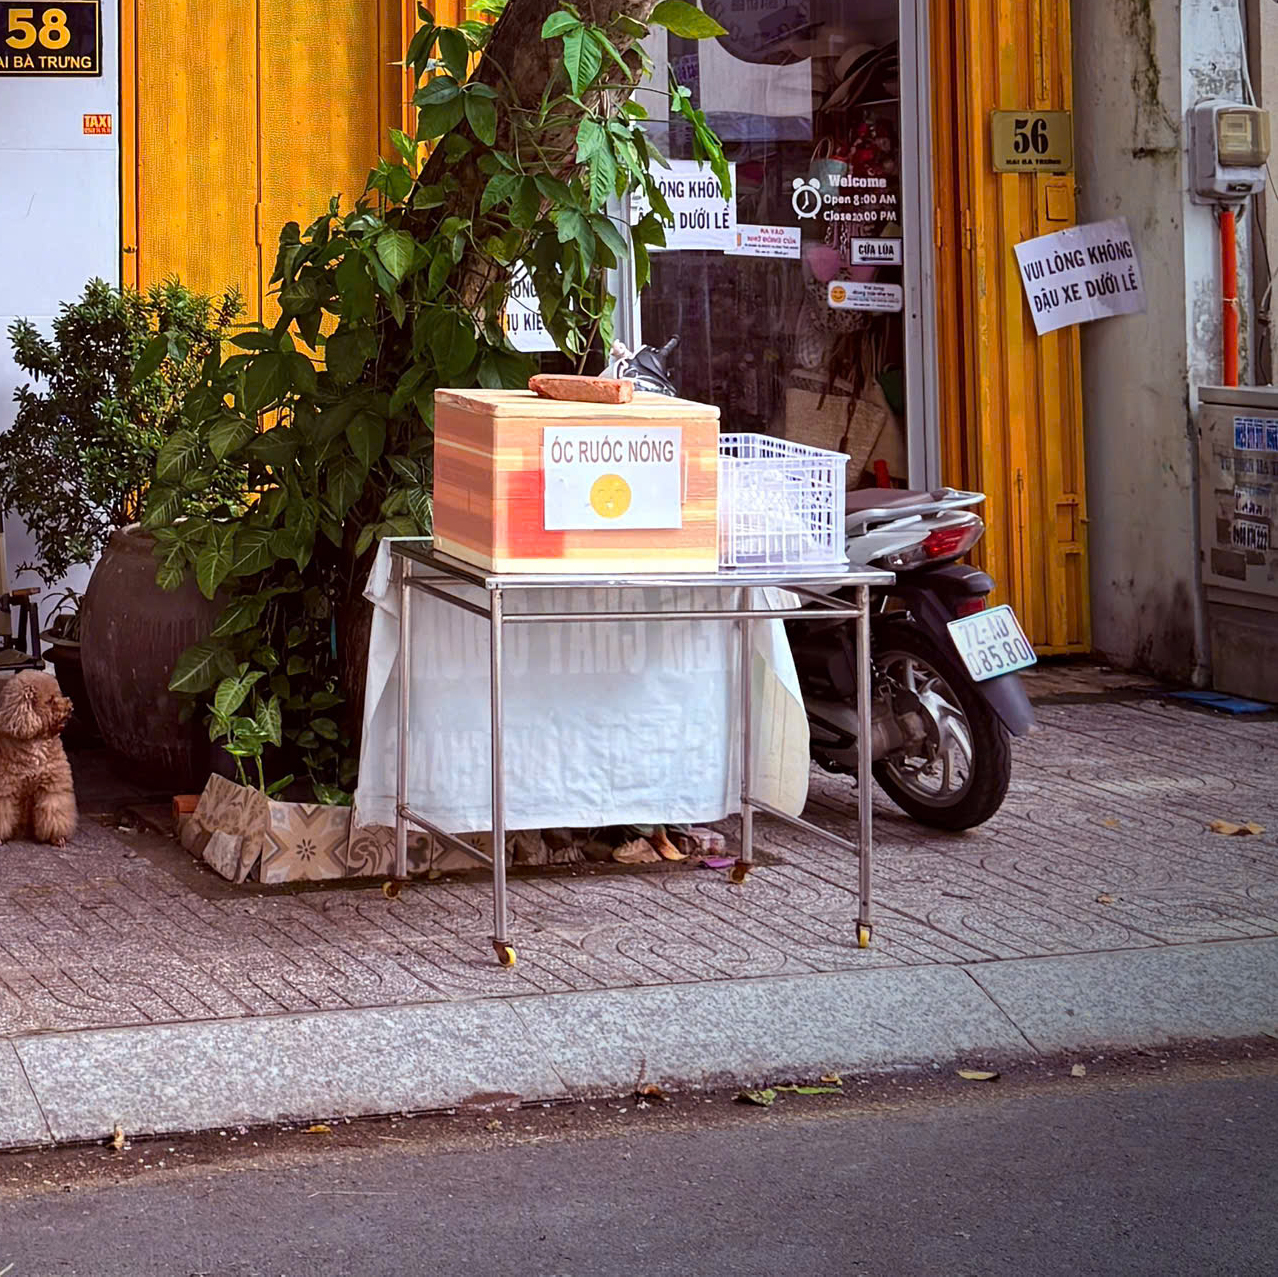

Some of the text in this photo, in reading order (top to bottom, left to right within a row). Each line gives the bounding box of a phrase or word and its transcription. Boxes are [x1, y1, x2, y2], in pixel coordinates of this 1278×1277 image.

[5, 7, 71, 50] 58
[13, 53, 35, 68] BÀ
[38, 56, 92, 69] TRƯNG
[84, 115, 111, 128] TAXI
[1013, 118, 1049, 154] 56
[658, 175, 685, 198] ÒNG
[688, 176, 724, 199] KHÔN
[828, 174, 887, 188] Welcome
[823, 193, 897, 206] Open 8:00 AM
[679, 207, 711, 229] DƯỚI
[880, 210, 897, 222] PM
[1023, 239, 1133, 282] VUI LÒNG KHÔNG
[1033, 287, 1060, 313] ĐẬU
[1062, 283, 1082, 305] XE
[1085, 271, 1121, 298] DƯỚI
[628, 434, 674, 463] NÓNG
[966, 637, 1029, 675] 085.80
